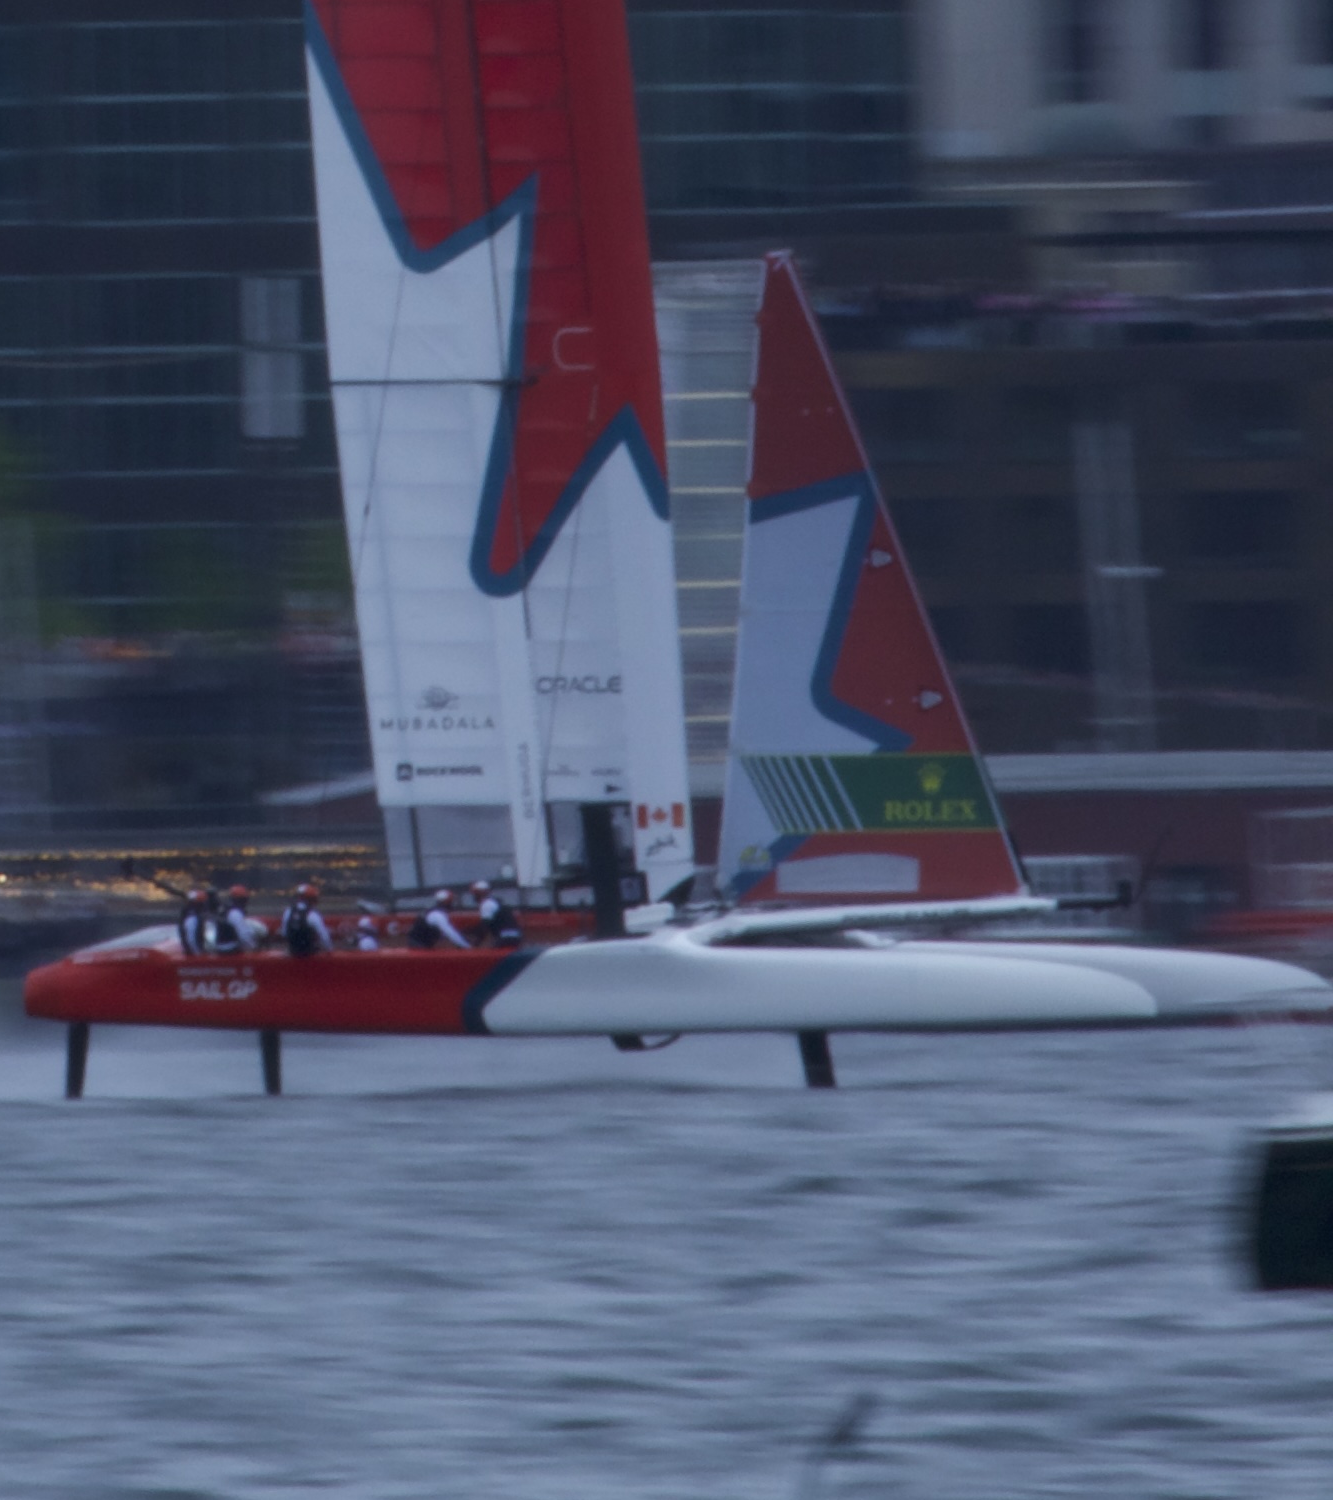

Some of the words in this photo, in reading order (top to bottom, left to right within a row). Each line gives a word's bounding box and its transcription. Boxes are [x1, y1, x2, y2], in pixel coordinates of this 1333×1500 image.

[536, 675, 622, 694] ORACLE
[380, 716, 495, 731] MUBADALA
[885, 799, 976, 821] ROLEX
